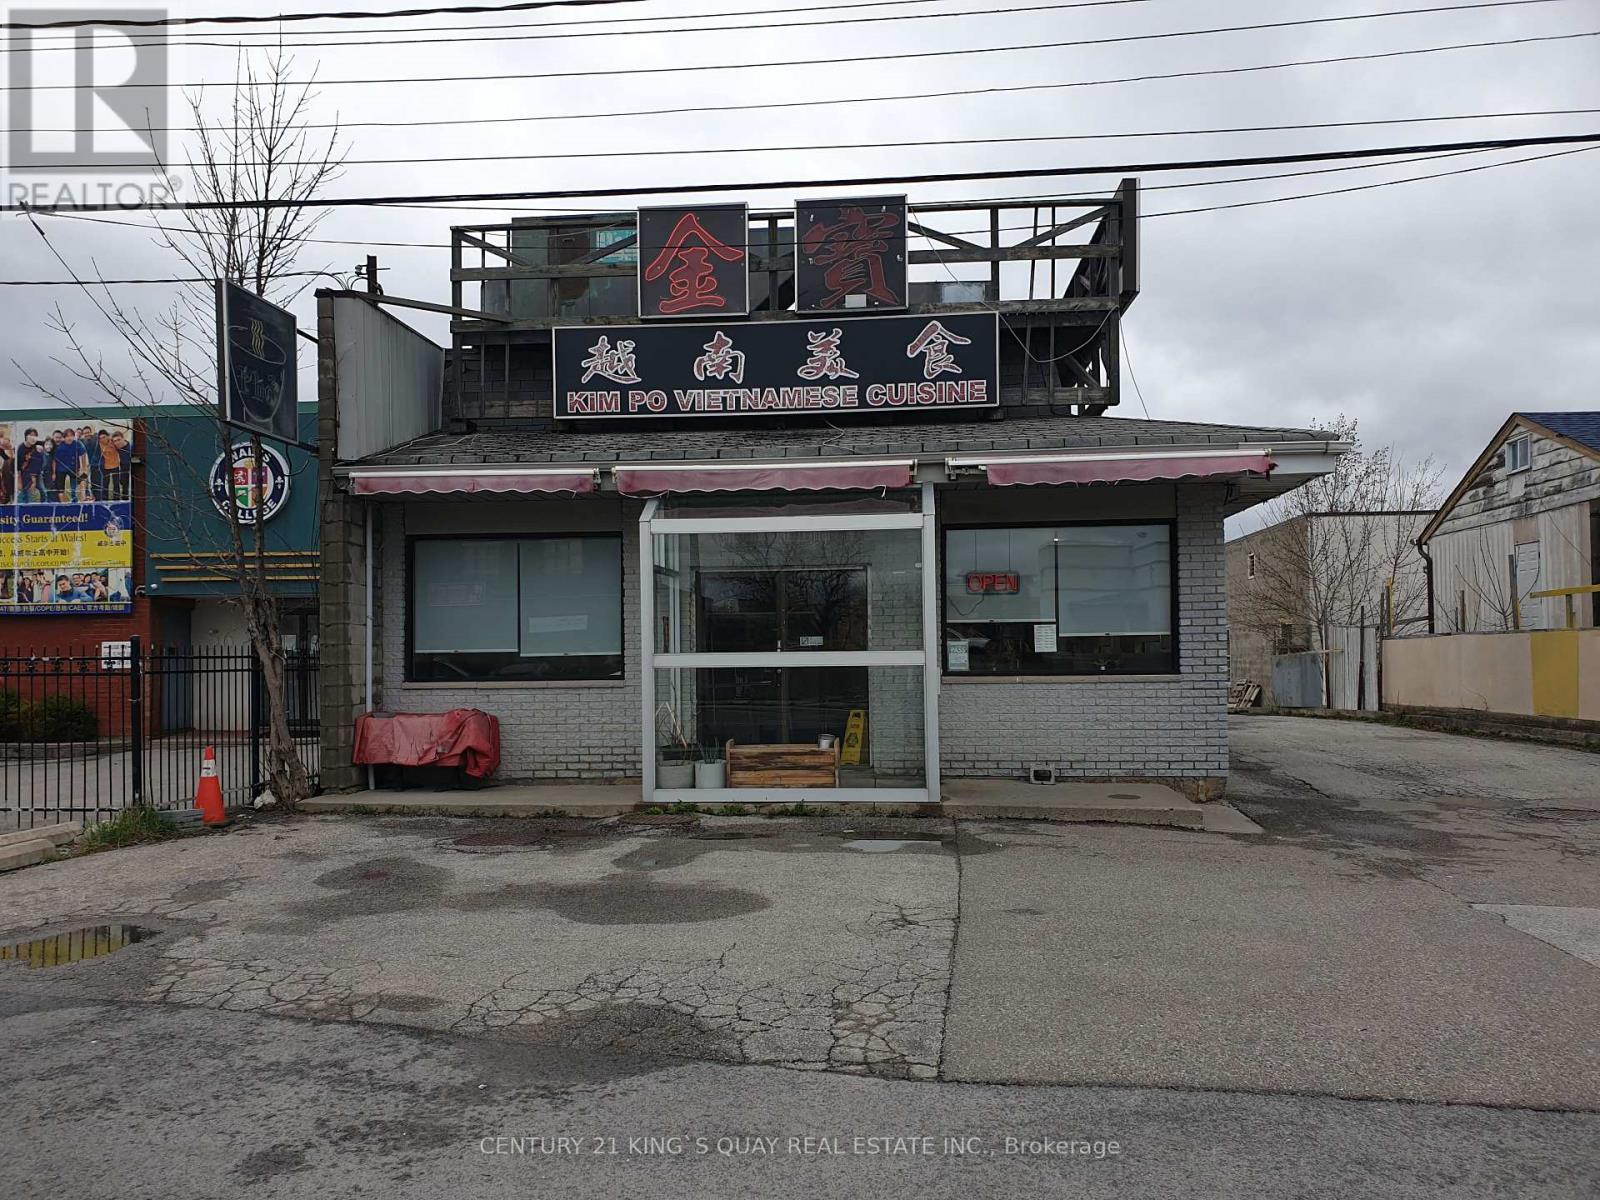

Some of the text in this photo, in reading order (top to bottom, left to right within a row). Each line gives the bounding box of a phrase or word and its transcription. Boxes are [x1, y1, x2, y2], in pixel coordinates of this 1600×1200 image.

[581, 320, 971, 384] 越南美食
[628, 390, 668, 412] PO
[673, 385, 858, 411] VIETNAMESE
[866, 380, 987, 405] CUISINE
[231, 446, 272, 463] WALS
[222, 498, 277, 519] CLLGE
[22, 513, 88, 524] Guaranteed!
[969, 574, 1018, 592] OPEN
